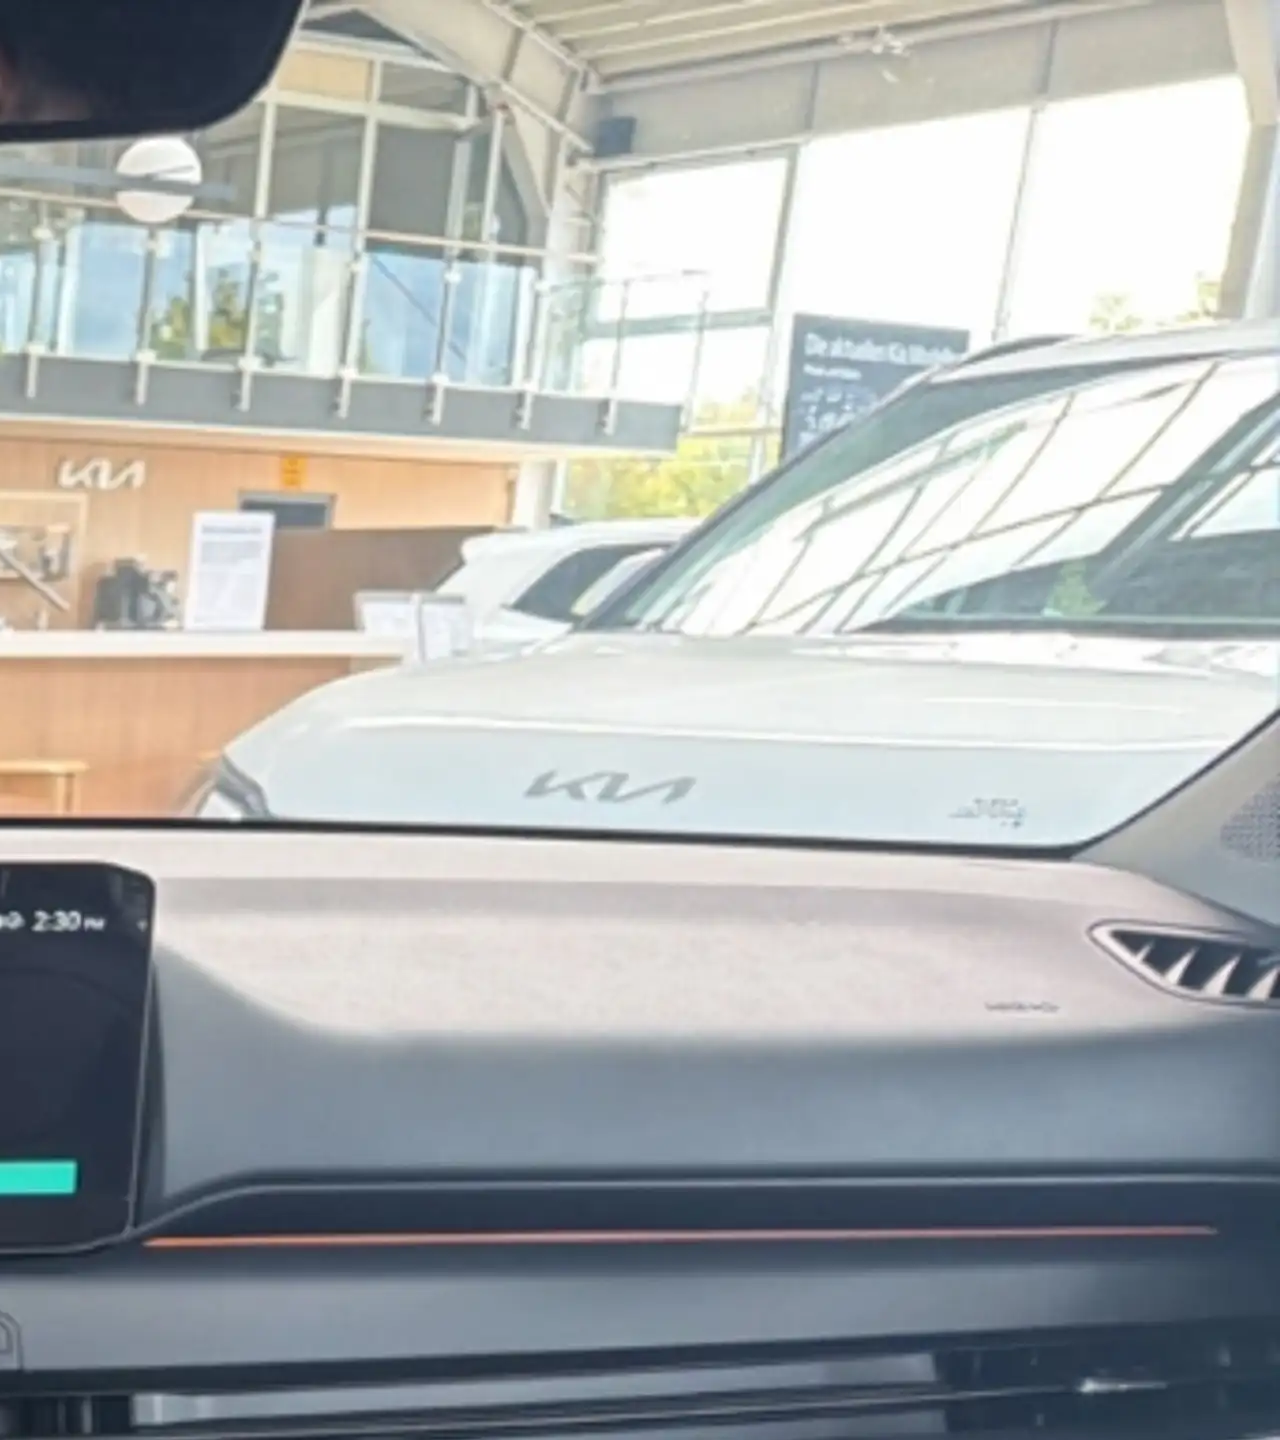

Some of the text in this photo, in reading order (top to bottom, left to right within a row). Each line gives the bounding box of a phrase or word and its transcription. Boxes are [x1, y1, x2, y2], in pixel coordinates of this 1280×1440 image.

[58, 458, 146, 489] KIA
[524, 768, 696, 804] KIA
[31, 909, 82, 933] 2:30
